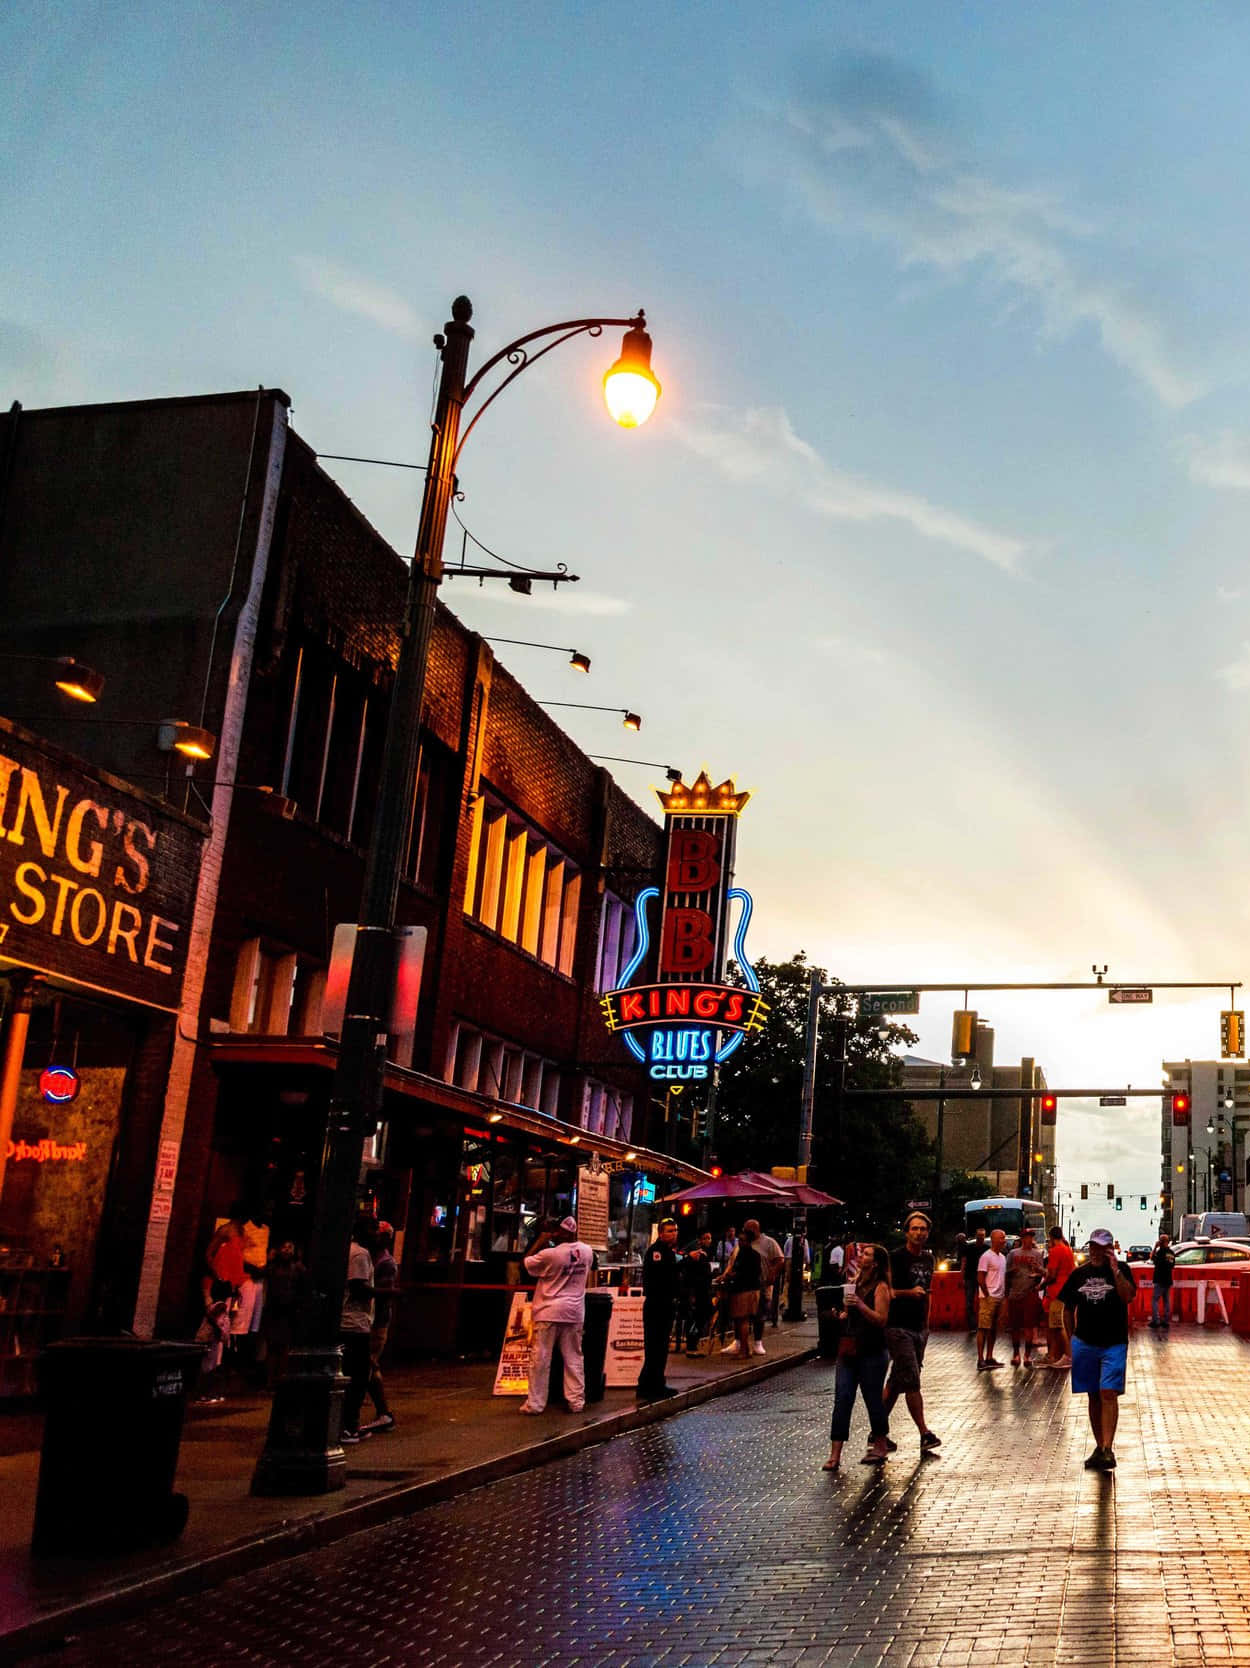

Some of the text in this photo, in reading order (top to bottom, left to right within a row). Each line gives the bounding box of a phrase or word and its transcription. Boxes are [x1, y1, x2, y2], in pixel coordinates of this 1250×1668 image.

[10, 861, 180, 975] STORE
[619, 988, 745, 1022] KING'S
[863, 997, 916, 1012] Second
[652, 1029, 711, 1062] BLUES
[649, 1065, 709, 1080] CLUB
[502, 1351, 529, 1361] HAPP
